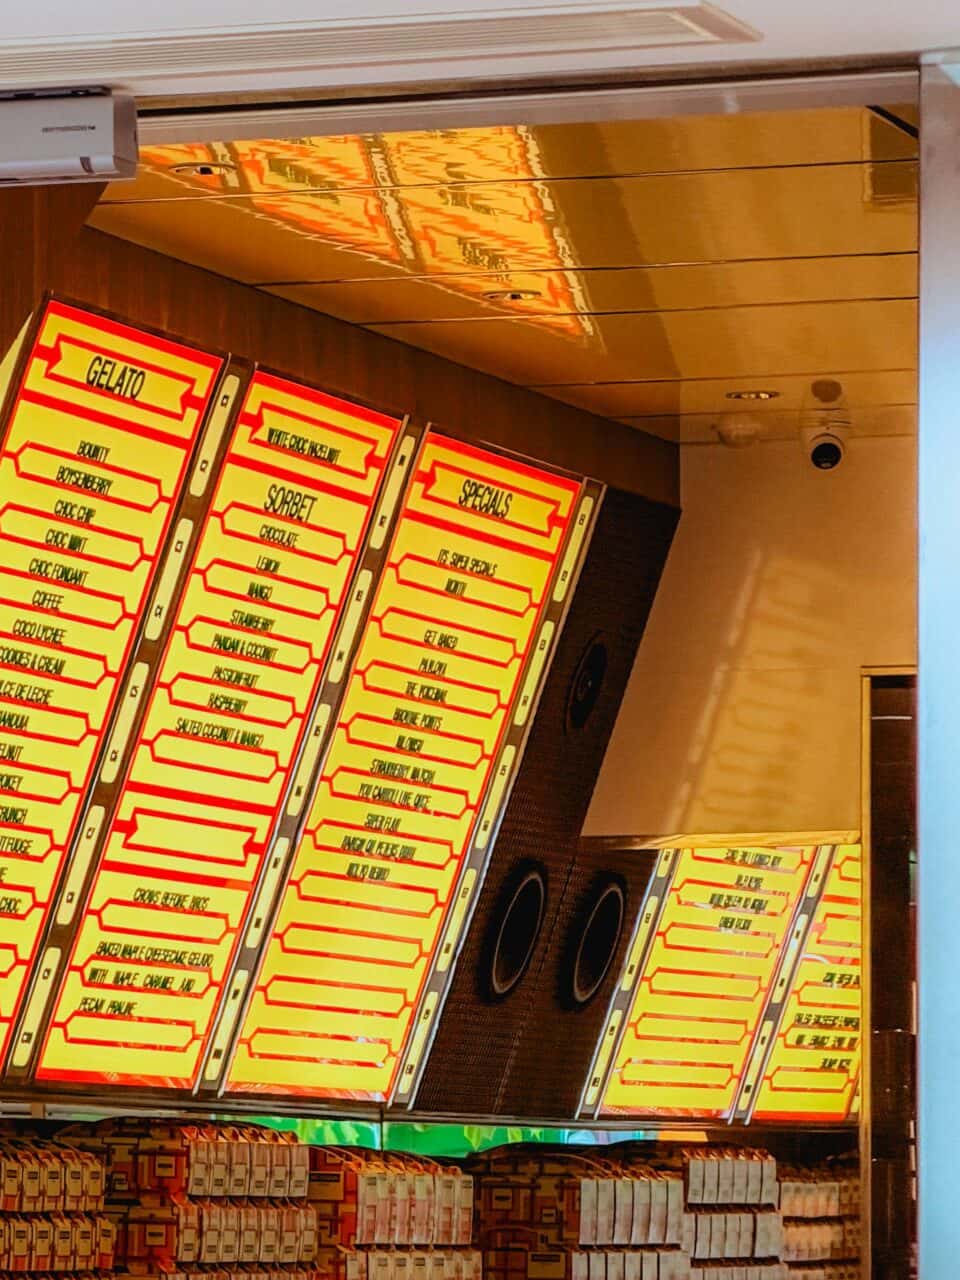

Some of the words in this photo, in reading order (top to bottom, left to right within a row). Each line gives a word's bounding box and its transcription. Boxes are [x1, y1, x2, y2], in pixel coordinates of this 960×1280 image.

[86, 356, 145, 399] GELATO
[288, 434, 308, 454] CHOC
[54, 500, 77, 518] CHOC
[264, 485, 317, 521] SORBET
[45, 529, 68, 548] CHOC
[29, 558, 52, 577] CHOC
[188, 952, 213, 967] GELATO
